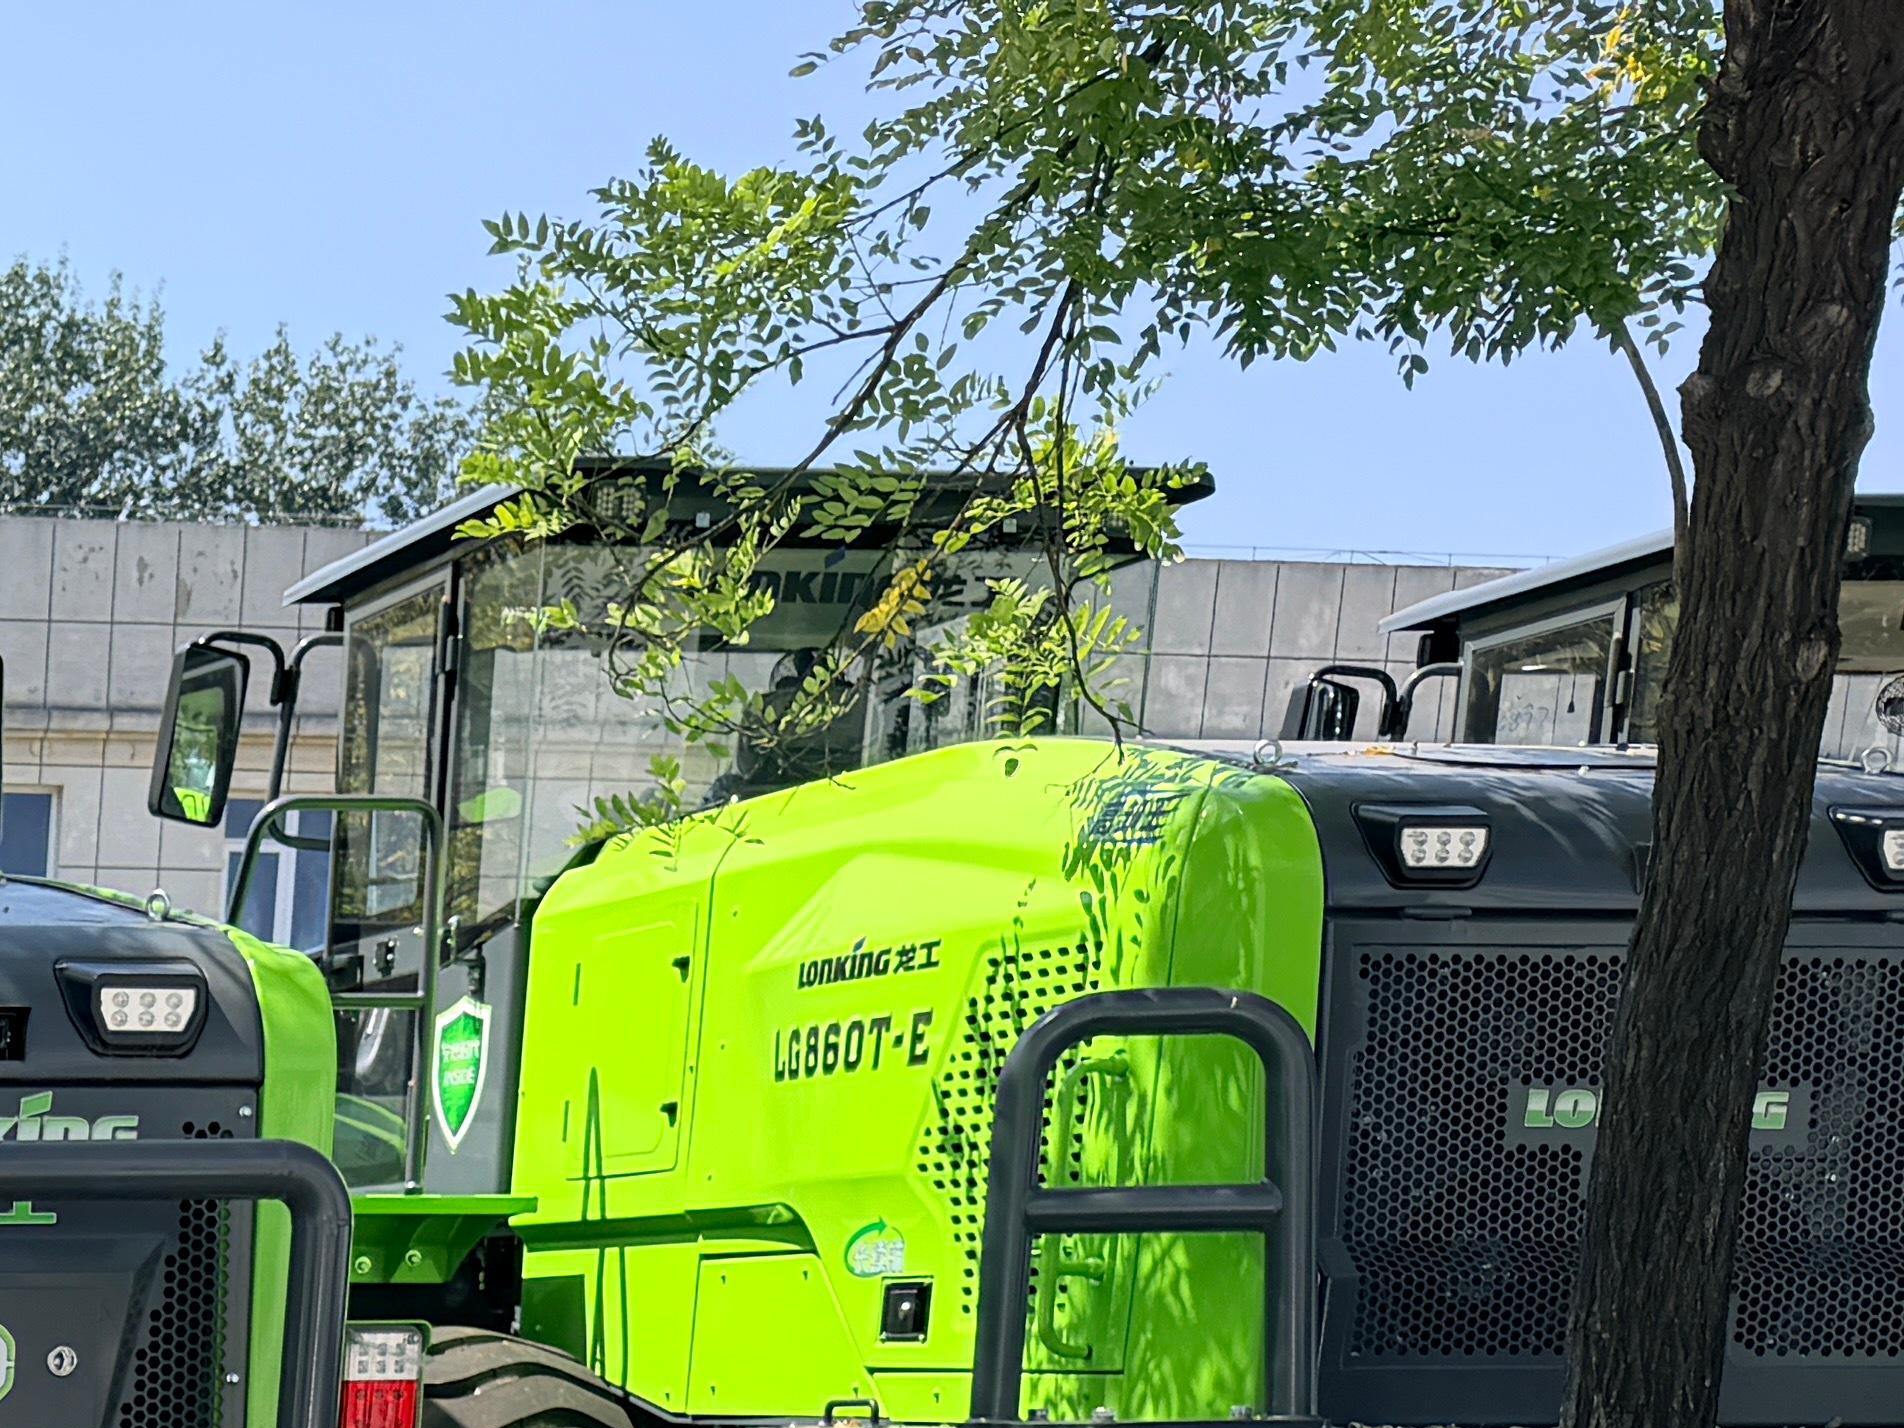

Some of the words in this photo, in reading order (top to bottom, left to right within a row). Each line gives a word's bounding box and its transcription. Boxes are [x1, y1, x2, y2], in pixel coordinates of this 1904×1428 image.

[797, 936, 892, 990] LONKING
[893, 939, 942, 975] 龙工
[774, 1007, 934, 1083] LG860T-E
